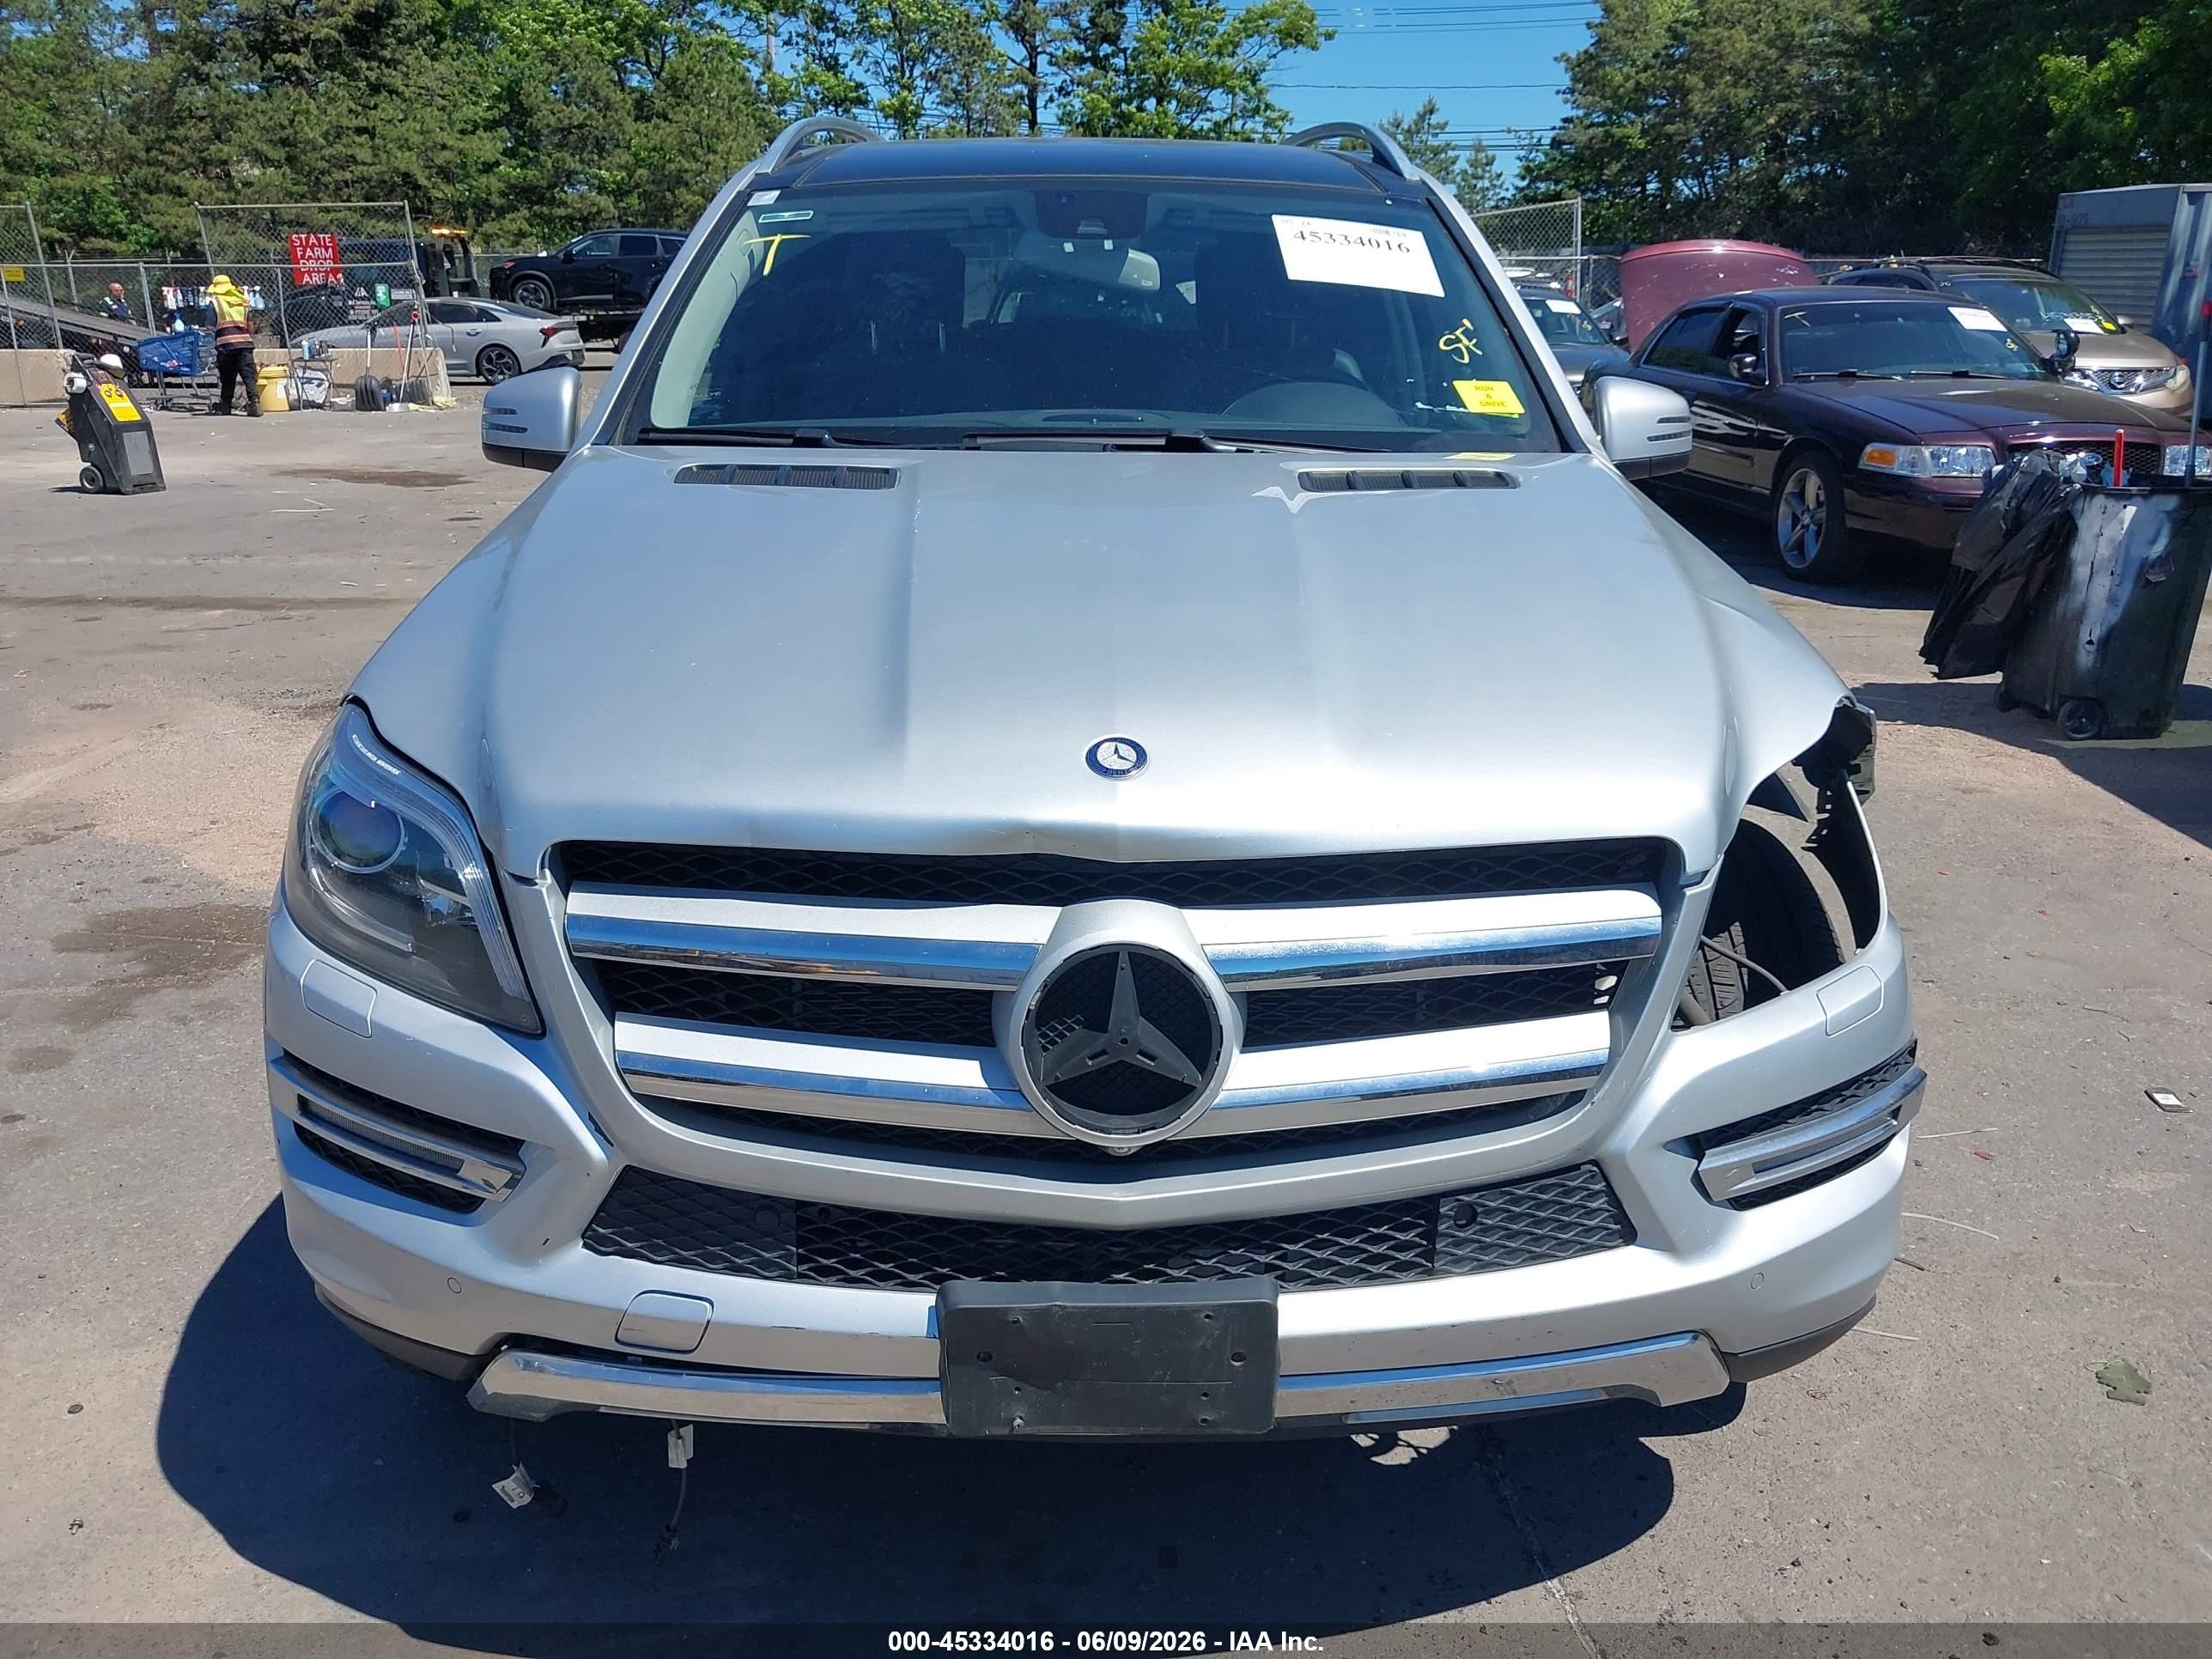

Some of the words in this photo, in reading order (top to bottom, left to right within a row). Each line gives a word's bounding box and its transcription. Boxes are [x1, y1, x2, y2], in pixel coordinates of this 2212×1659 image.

[291, 234, 333, 246] STATE
[1293, 229, 1411, 253] 45334016
[296, 247, 333, 259] FARM
[301, 259, 334, 271] DROP
[302, 273, 337, 285] AREA
